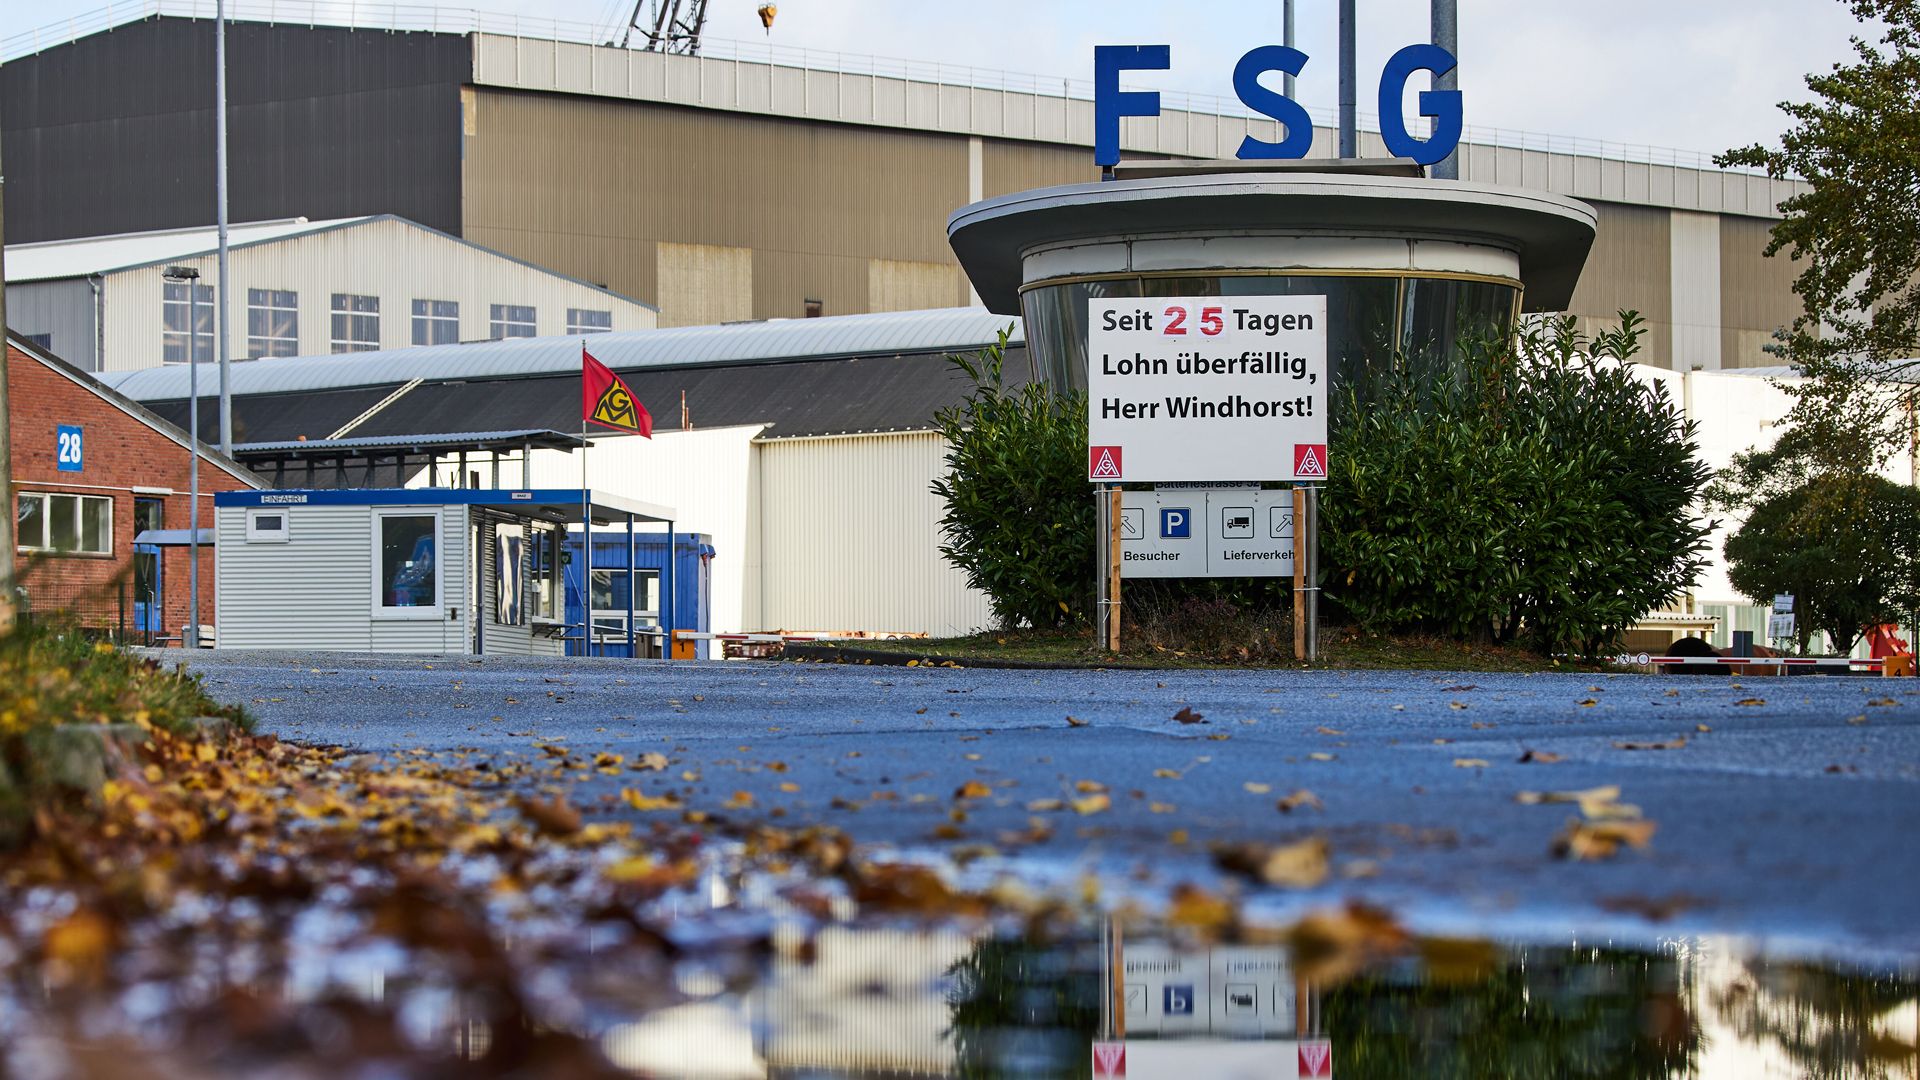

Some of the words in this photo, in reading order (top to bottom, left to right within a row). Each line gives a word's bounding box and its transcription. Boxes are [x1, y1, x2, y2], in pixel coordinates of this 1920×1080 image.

[1102, 309, 1153, 331] Seit
[1232, 309, 1313, 336] Tagen
[1102, 352, 1168, 375] Lohn
[1175, 351, 1317, 385] überfällig,
[1102, 397, 1159, 419] Herr
[1165, 395, 1313, 419] Windhorst!
[59, 432, 82, 464] 28
[264, 495, 304, 503] EINFAHRT
[1124, 551, 1180, 561] Besucher
[1223, 550, 1295, 560] Lieferverkeh
[679, 642, 685, 652] 1
[1894, 668, 1902, 677] 4
